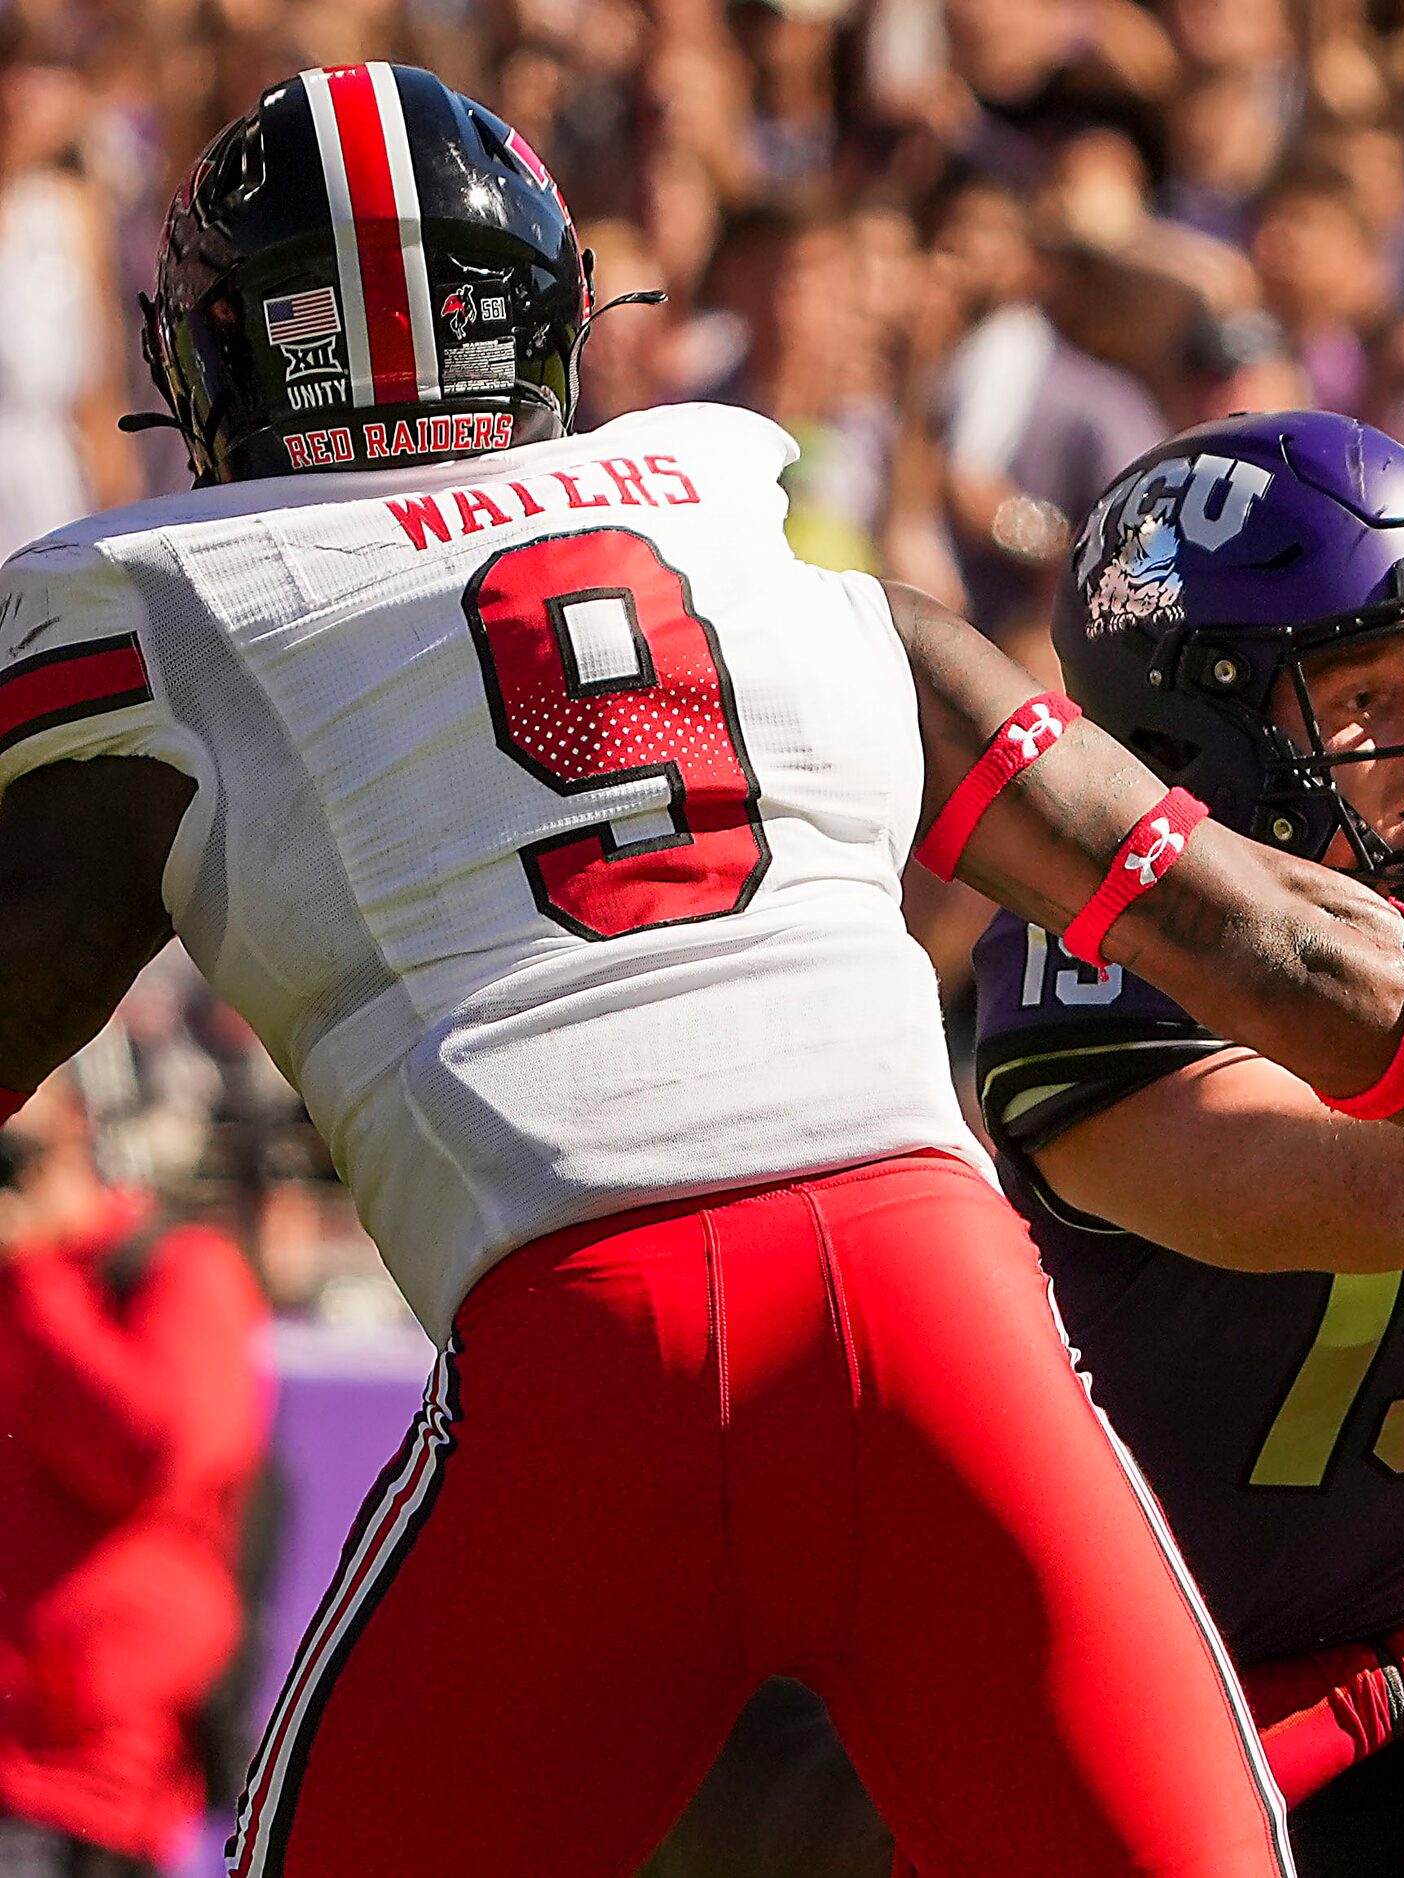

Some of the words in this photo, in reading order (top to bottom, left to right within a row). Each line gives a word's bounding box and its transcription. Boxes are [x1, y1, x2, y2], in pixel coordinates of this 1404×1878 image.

[481, 297, 506, 320] 561
[286, 378, 347, 411] UNITY
[283, 427, 354, 469] RED
[363, 412, 514, 458] RAIDERS
[383, 454, 701, 551] WATERS
[461, 525, 773, 943] 9
